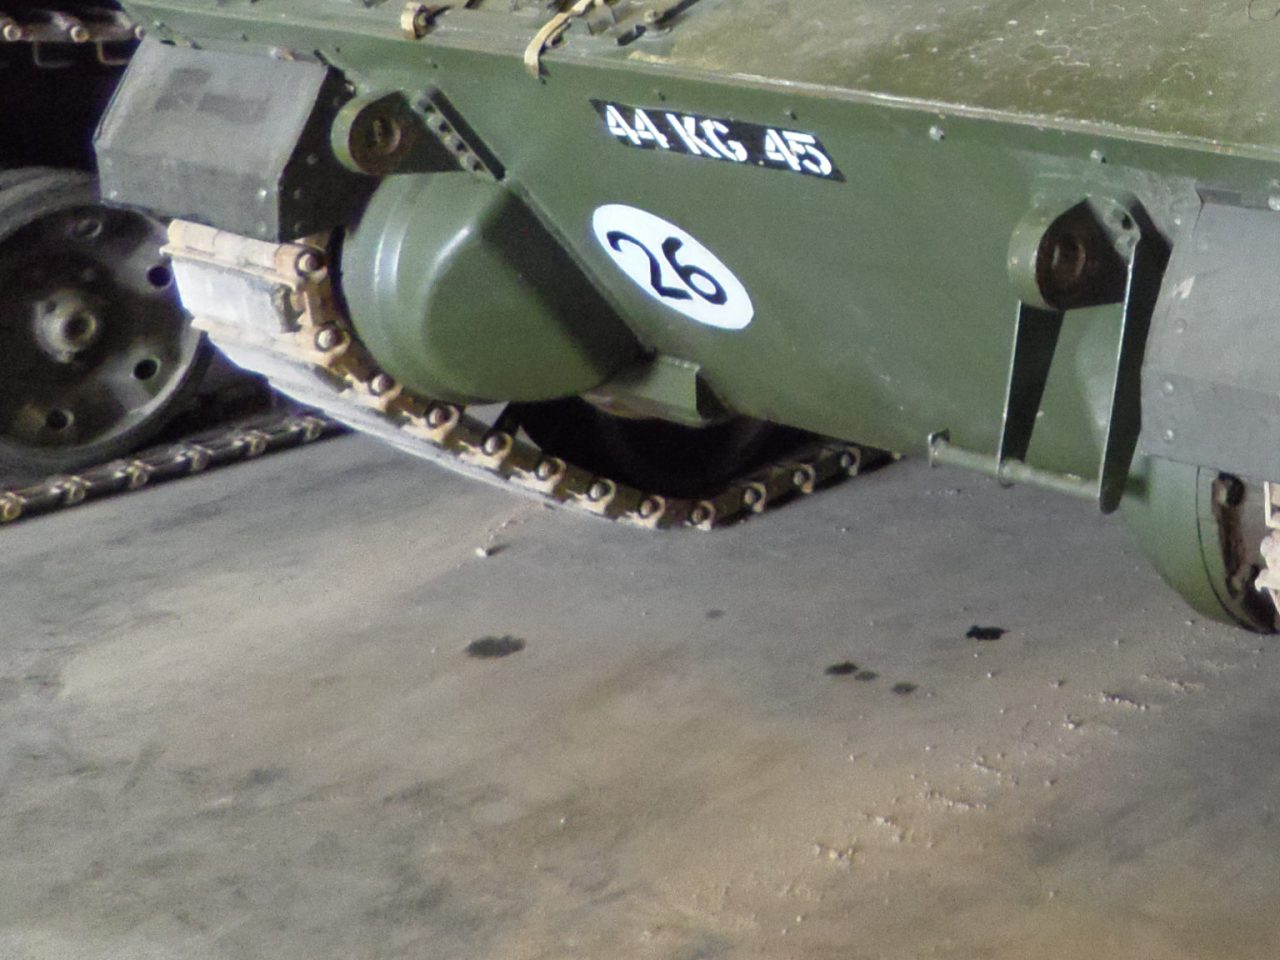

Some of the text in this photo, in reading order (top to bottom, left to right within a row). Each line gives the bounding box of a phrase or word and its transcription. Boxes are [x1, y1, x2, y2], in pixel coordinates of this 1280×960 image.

[606, 104, 832, 176] 44 KG 45
[606, 230, 728, 305] 26
